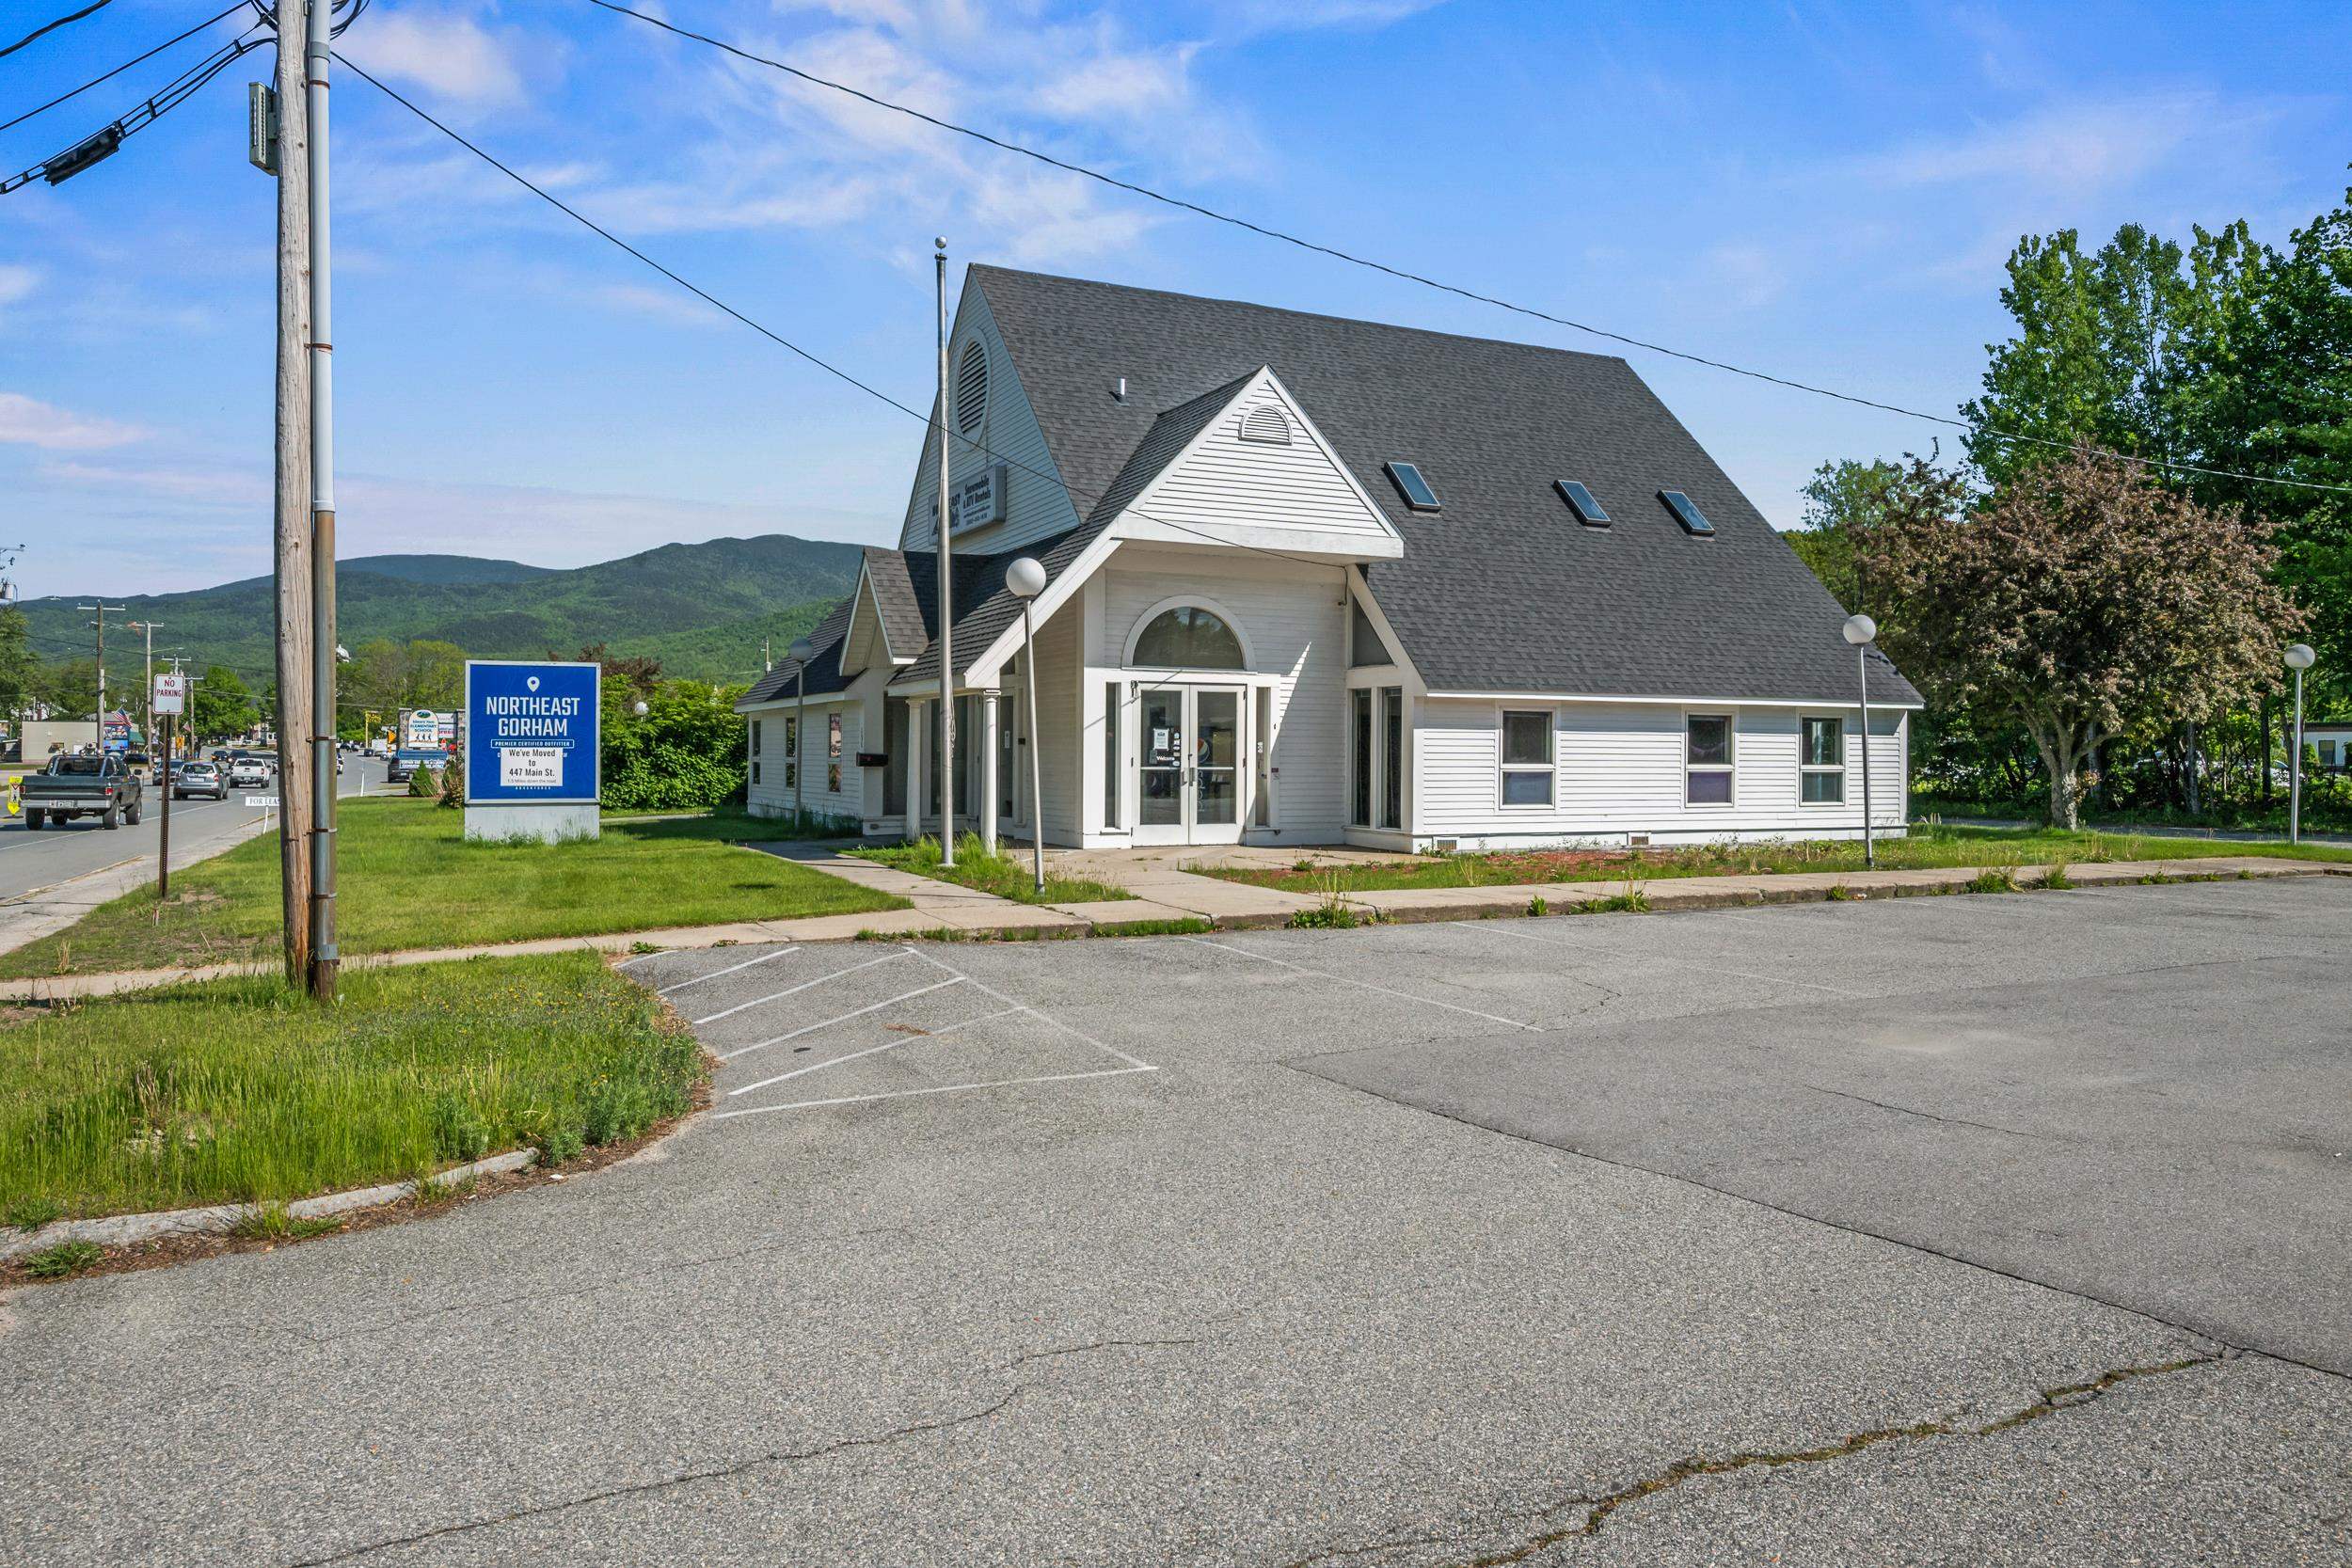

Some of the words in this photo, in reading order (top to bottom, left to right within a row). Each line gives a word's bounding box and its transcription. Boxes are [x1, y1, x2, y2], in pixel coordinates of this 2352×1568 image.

[165, 679, 175, 688] NO
[156, 689, 183, 697] PARKING
[486, 696, 580, 715] NORTHEAST
[498, 718, 567, 736] GORHAM
[509, 749, 531, 757] We've
[532, 749, 556, 757] Moved
[509, 768, 523, 777] 447
[525, 768, 543, 777] Main
[545, 768, 555, 777] St.
